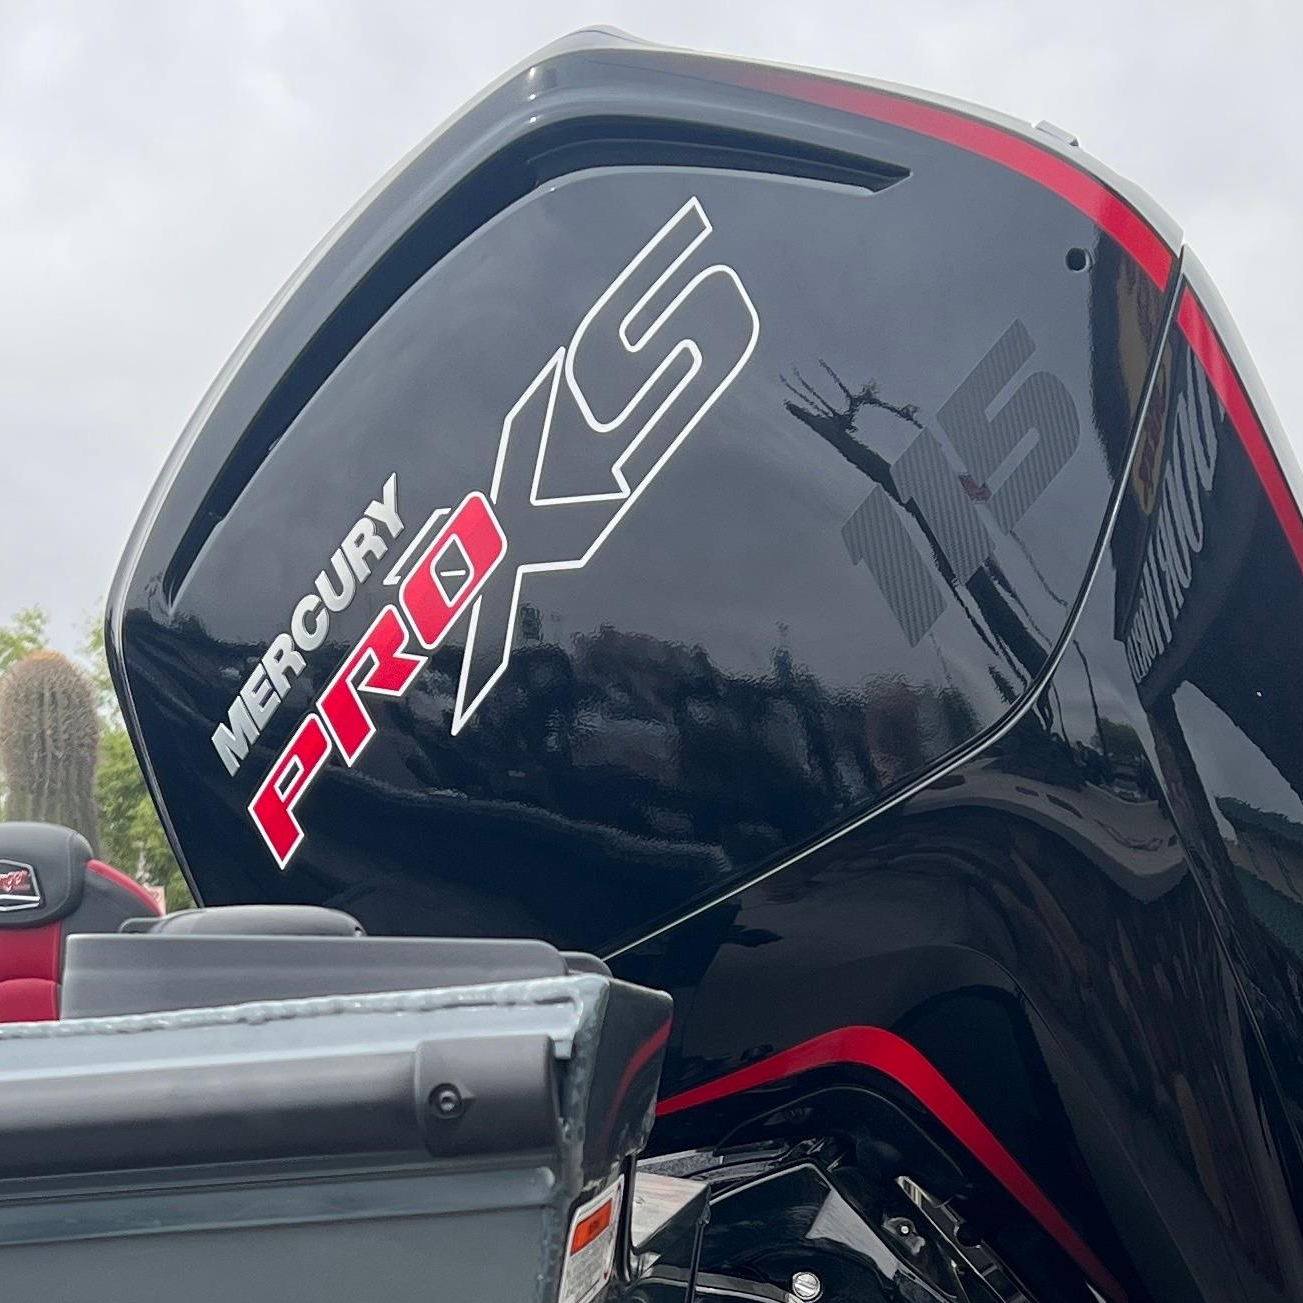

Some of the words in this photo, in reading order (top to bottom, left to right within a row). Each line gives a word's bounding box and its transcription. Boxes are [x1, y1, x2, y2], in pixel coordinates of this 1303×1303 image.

[211, 473, 406, 777] MERCURY
[840, 318, 1081, 648] 115
[247, 490, 508, 871] PRO
